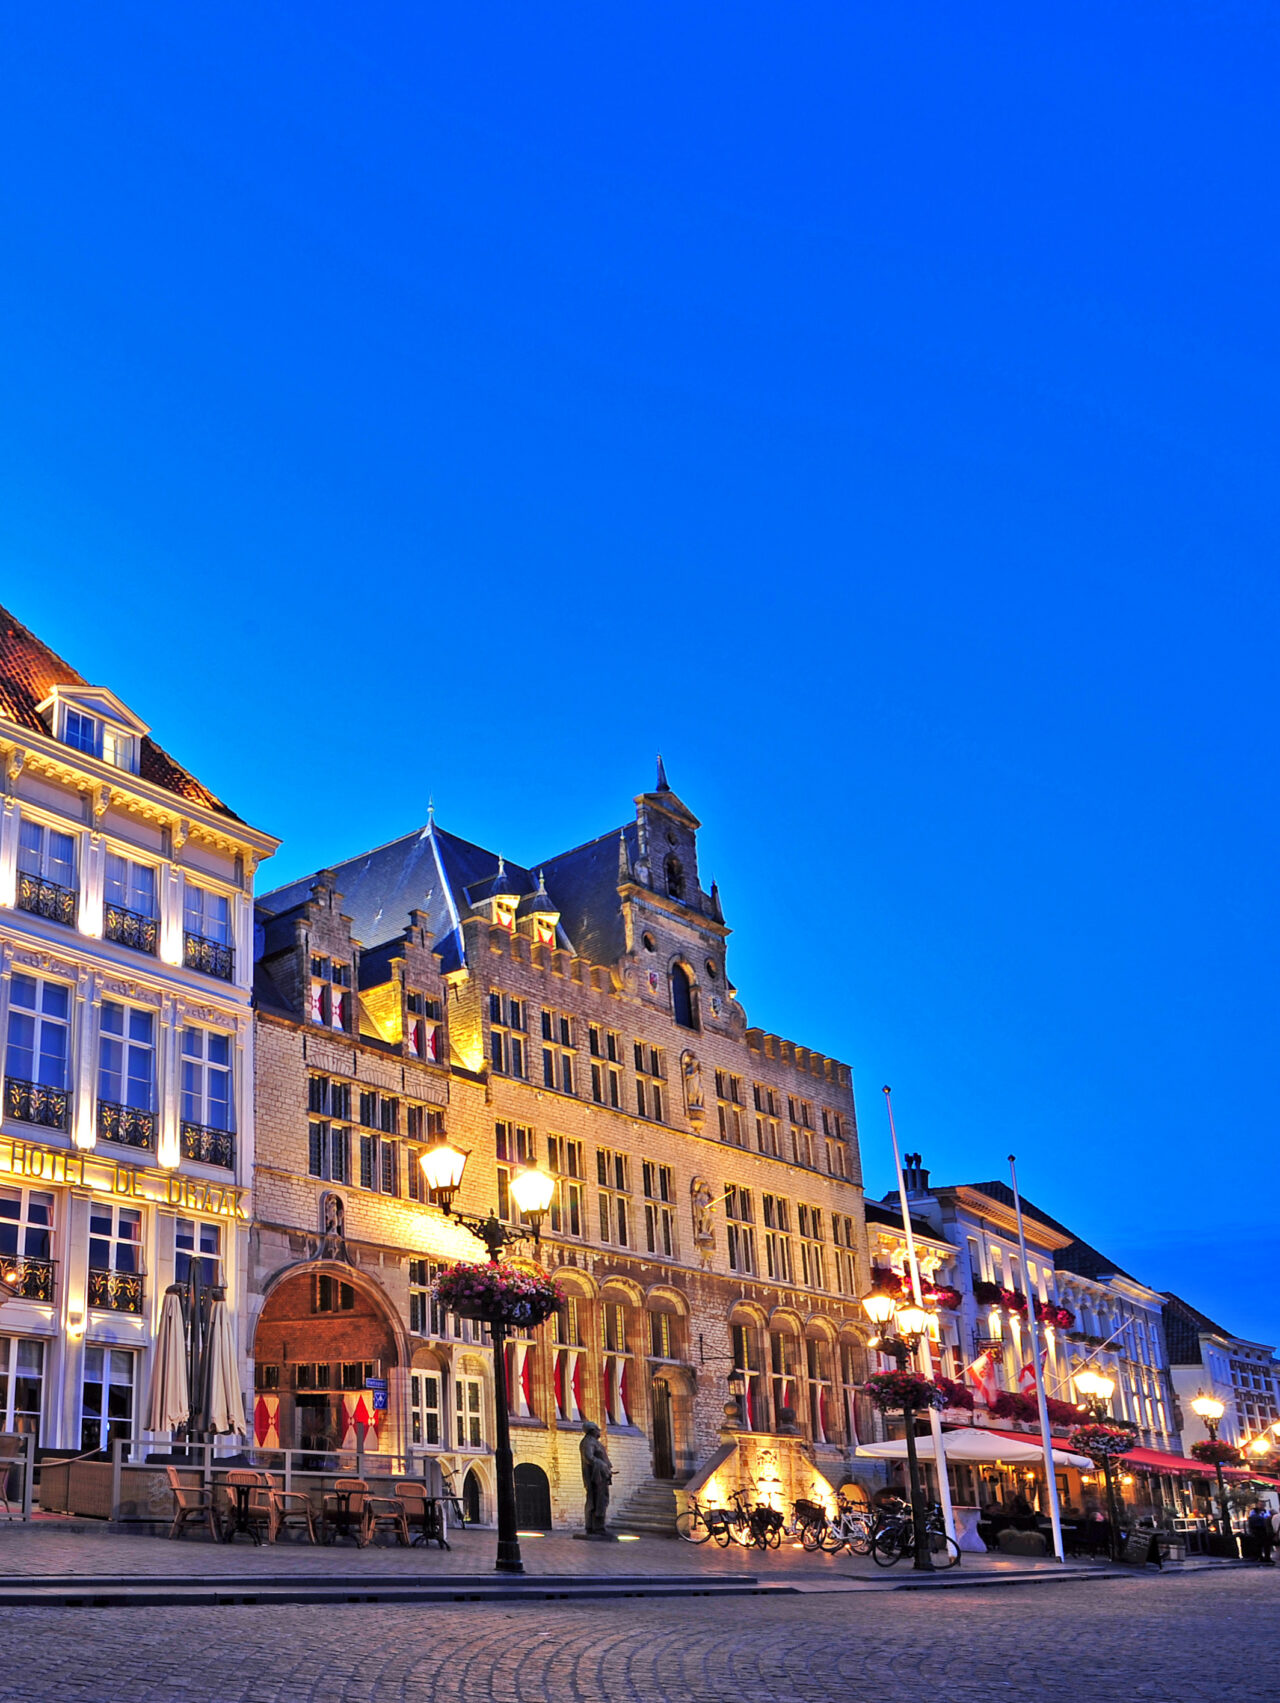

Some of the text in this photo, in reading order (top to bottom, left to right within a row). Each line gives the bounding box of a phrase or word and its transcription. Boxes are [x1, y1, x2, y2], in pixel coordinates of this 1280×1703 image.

[10, 1141, 92, 1188] HOTEL
[113, 1165, 145, 1198] DE
[168, 1177, 249, 1219] DRAAK
